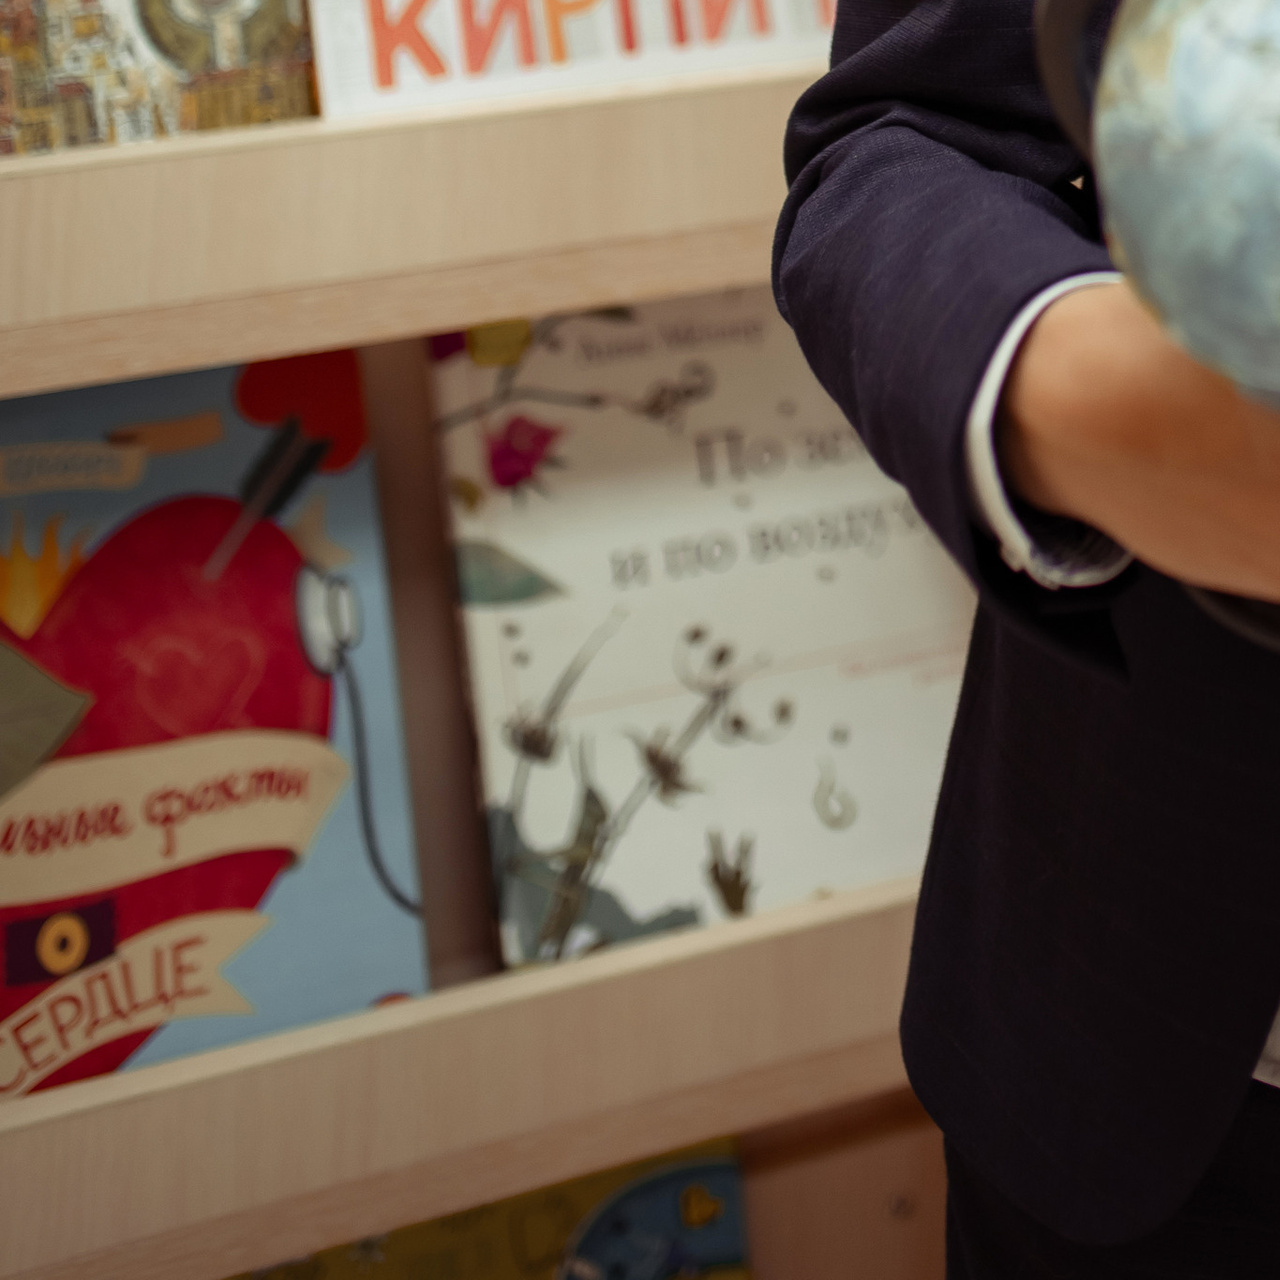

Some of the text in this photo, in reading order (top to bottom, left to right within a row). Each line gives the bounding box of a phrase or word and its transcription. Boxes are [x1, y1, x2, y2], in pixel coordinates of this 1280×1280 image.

[695, 422, 789, 488] По
[609, 549, 651, 592] и
[664, 532, 739, 582] по
[143, 768, 313, 860] факты
